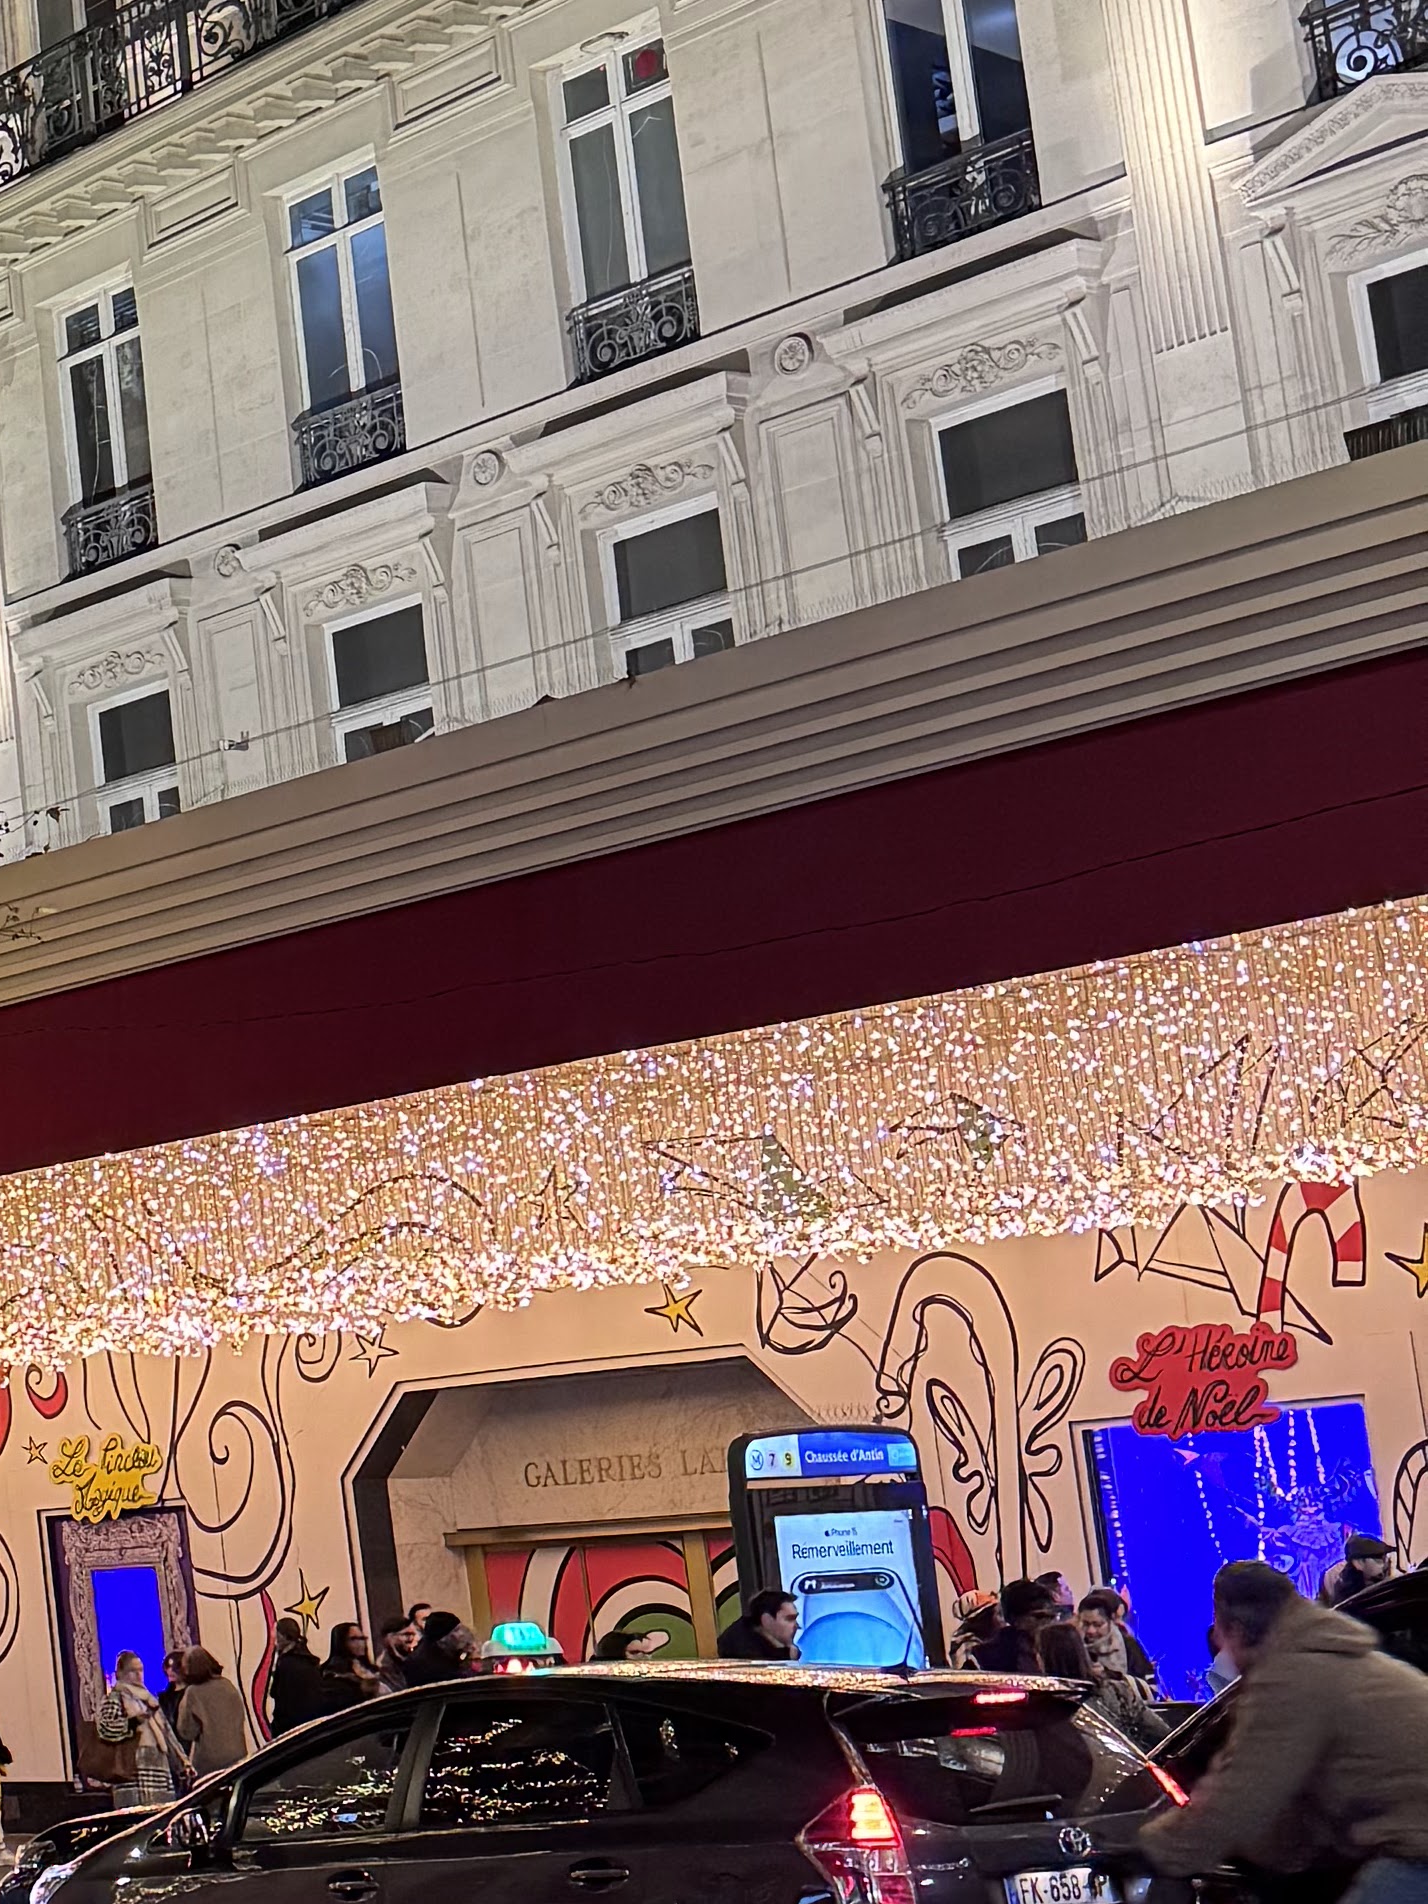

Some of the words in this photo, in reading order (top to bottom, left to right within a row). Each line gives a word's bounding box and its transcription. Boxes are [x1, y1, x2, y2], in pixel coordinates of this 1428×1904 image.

[1115, 1326, 1291, 1382] L'Héroïne
[1138, 1386, 1172, 1429] de
[1173, 1380, 1273, 1435] Noël
[52, 1438, 90, 1478] Le
[524, 1453, 663, 1488] GALERIES
[769, 1453, 775, 1467] 7
[784, 1452, 792, 1466] 9
[805, 1449, 848, 1464] Chaussée
[850, 1447, 885, 1461] d'Antin
[75, 1472, 154, 1517] Magique
[792, 1540, 894, 1559] Rémerveillement
